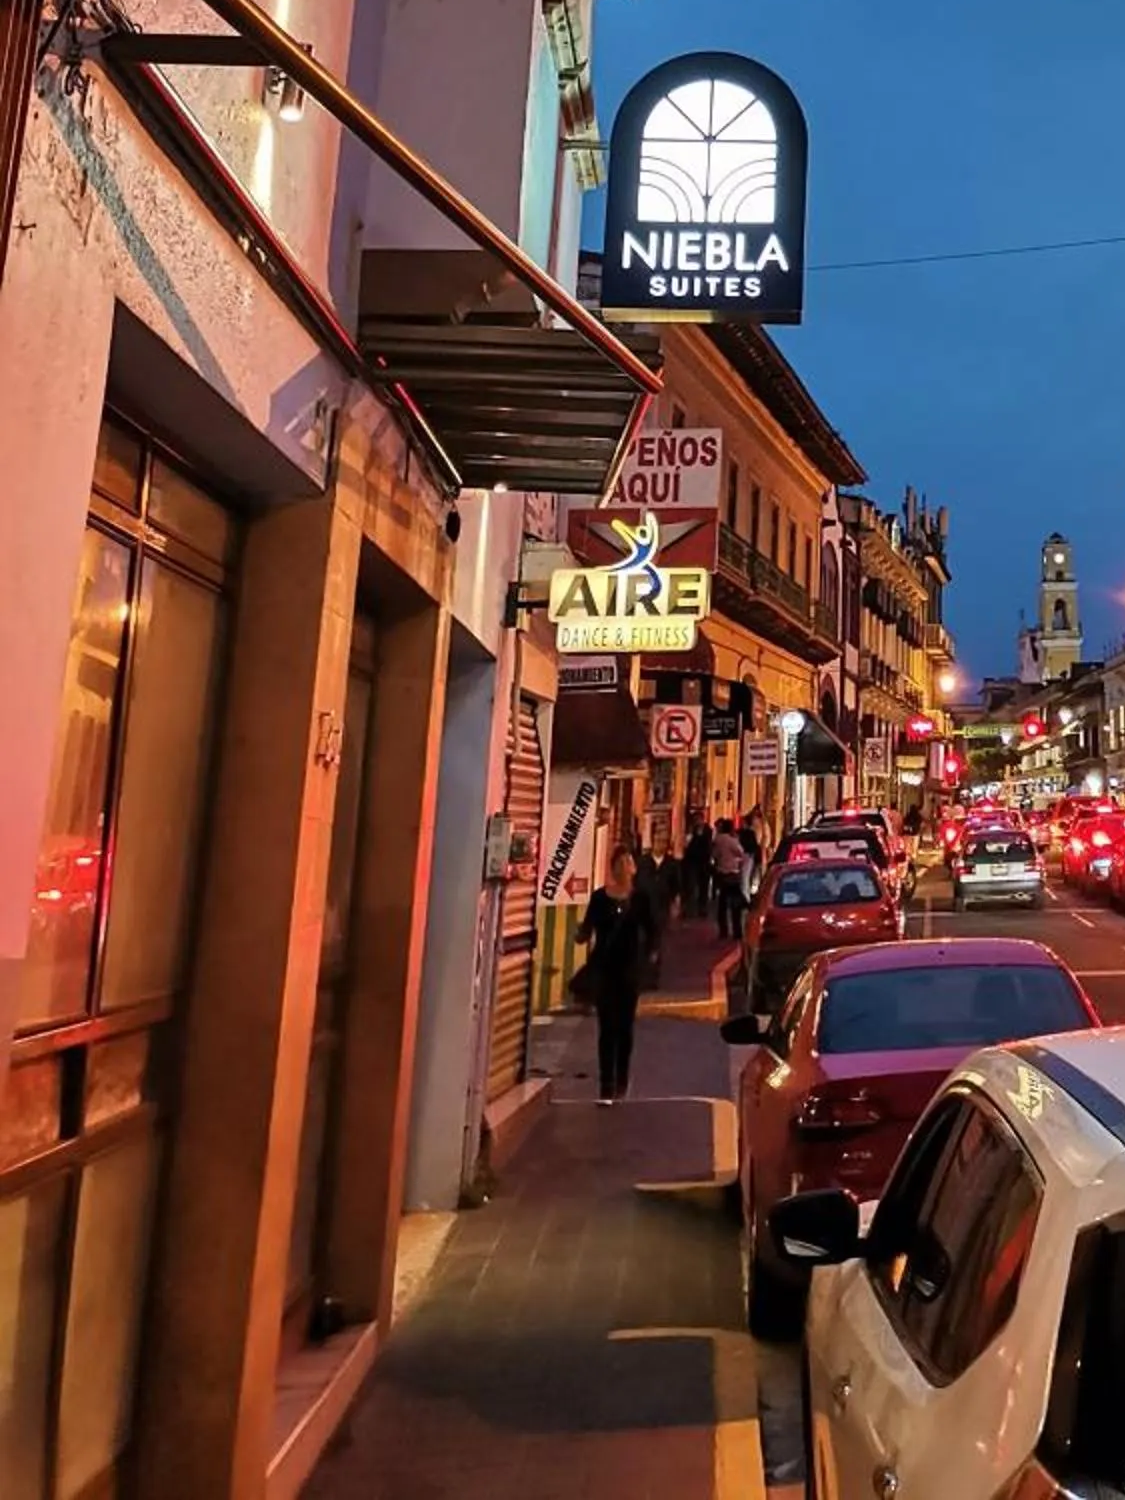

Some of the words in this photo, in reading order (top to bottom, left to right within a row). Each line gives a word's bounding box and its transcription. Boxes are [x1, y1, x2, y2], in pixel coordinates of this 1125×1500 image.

[621, 230, 788, 272] NIEBLA
[650, 276, 761, 297] SUITES
[555, 573, 702, 617] AIRE
[561, 627, 609, 647] DANCE
[615, 627, 624, 647] &
[631, 627, 689, 647] FITNESS
[541, 781, 596, 901] ESTACIONAMIENTO
